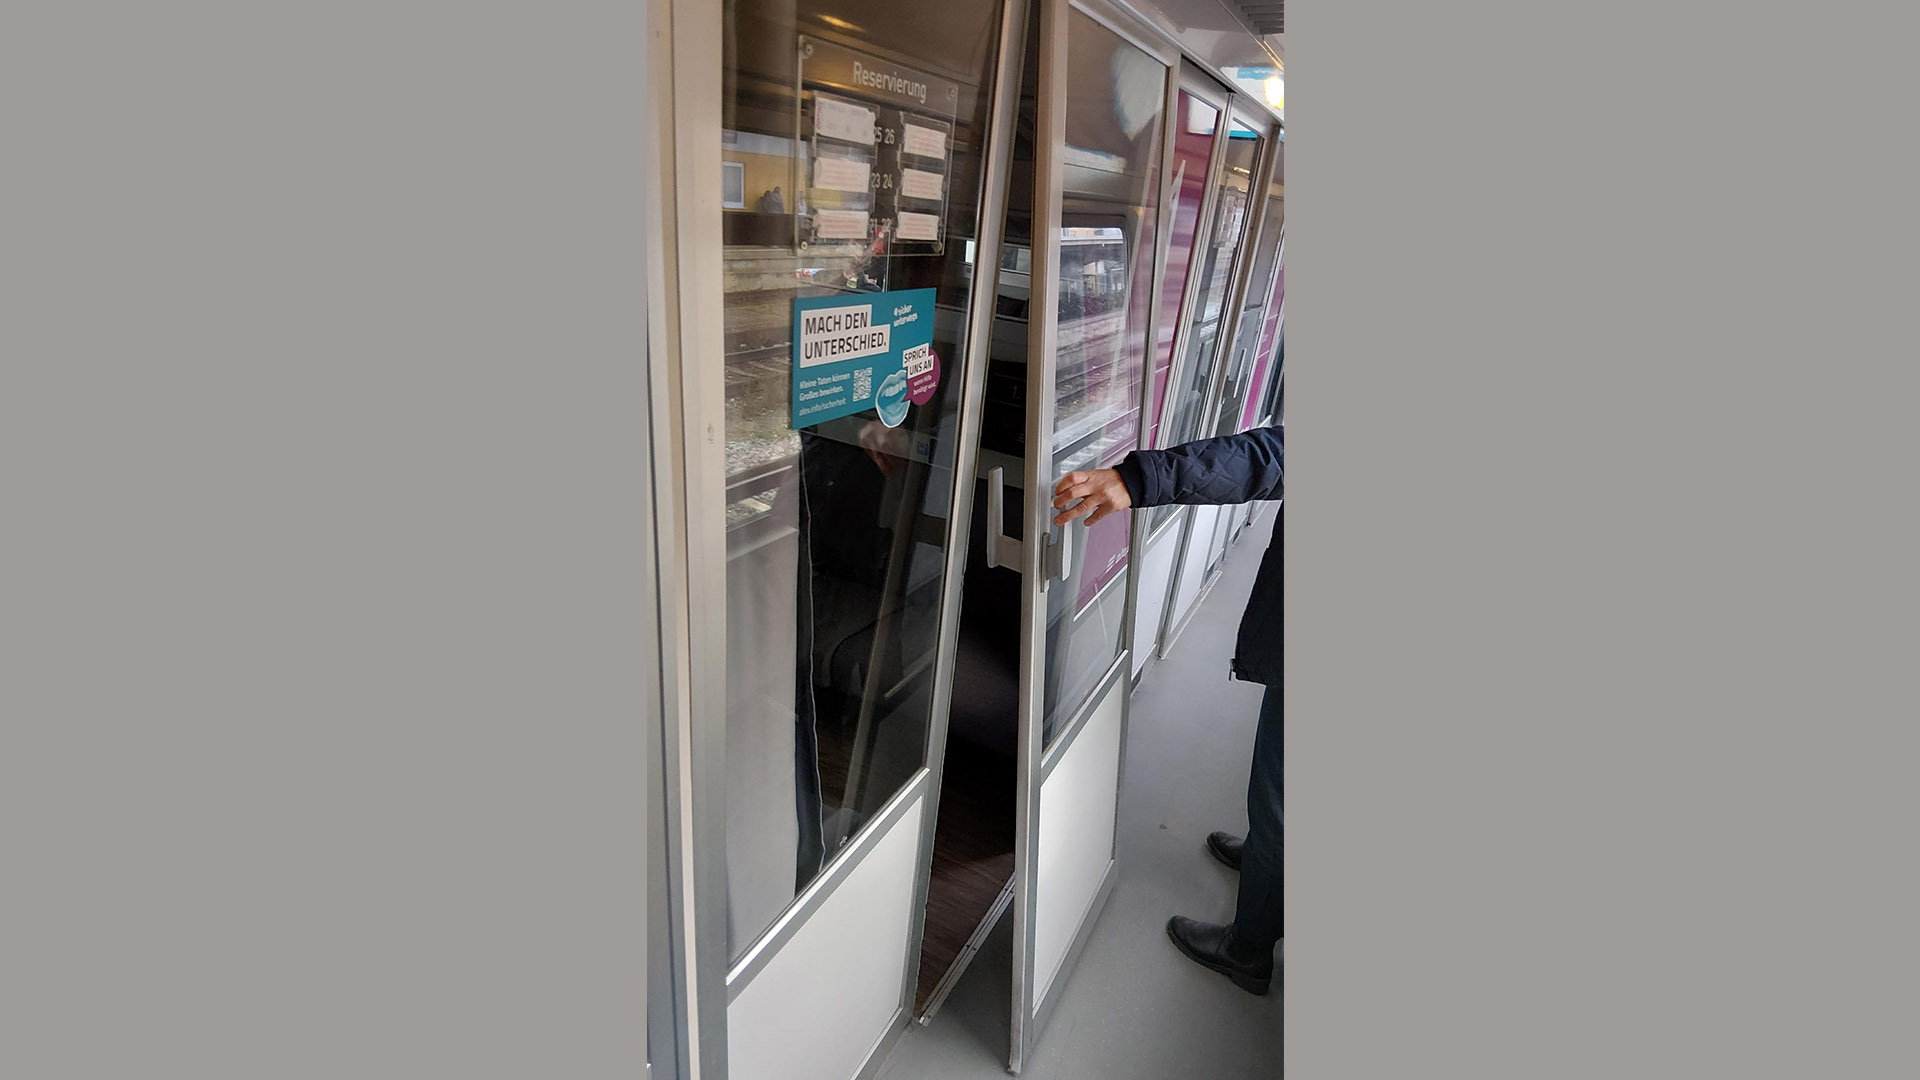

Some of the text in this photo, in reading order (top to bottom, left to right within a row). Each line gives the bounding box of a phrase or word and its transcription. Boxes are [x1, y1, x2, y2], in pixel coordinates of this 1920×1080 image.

[852, 60, 927, 103] Reservierung
[873, 126, 883, 142] 25
[884, 128, 895, 145] 26
[871, 172, 881, 189] 23
[882, 173, 893, 189] 24
[805, 311, 868, 335] MACH DEN
[894, 313, 918, 327] unterwegs
[804, 331, 887, 360] UNTERSCHIED.
[904, 347, 927, 363] SPRICH
[909, 359, 932, 376] UNS AN
[800, 372, 850, 389] Kleine Taten können
[800, 386, 843, 401] Großes bewirken.
